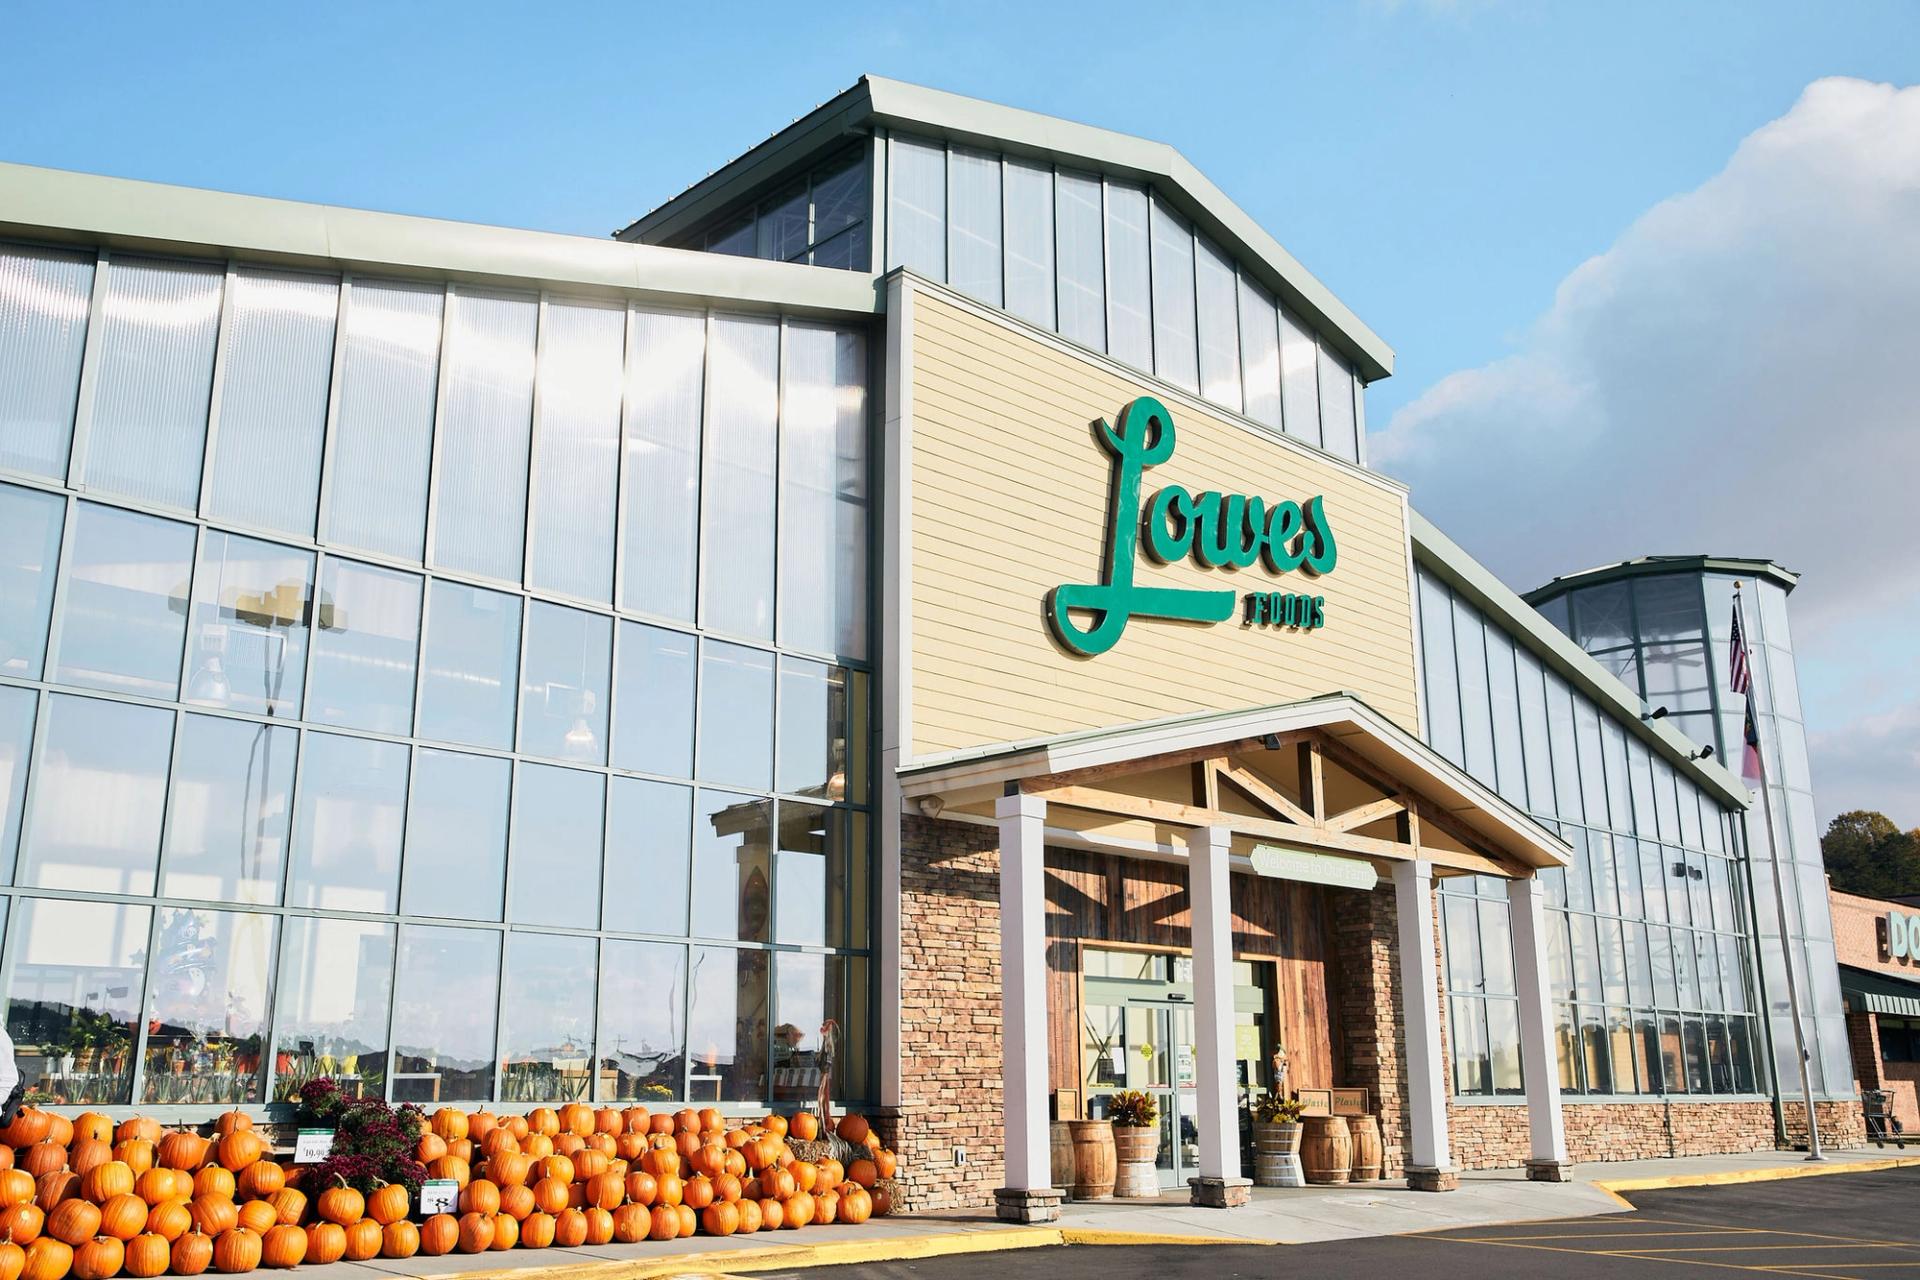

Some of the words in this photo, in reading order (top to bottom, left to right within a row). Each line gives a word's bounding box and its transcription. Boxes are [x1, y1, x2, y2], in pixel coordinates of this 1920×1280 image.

[1048, 395, 1338, 656] Lowes
[1248, 591, 1325, 629] FOODS
[1258, 851, 1309, 872] Welcome
[1312, 862, 1322, 873] to
[1323, 861, 1344, 878] Our
[1344, 864, 1369, 881] Farm
